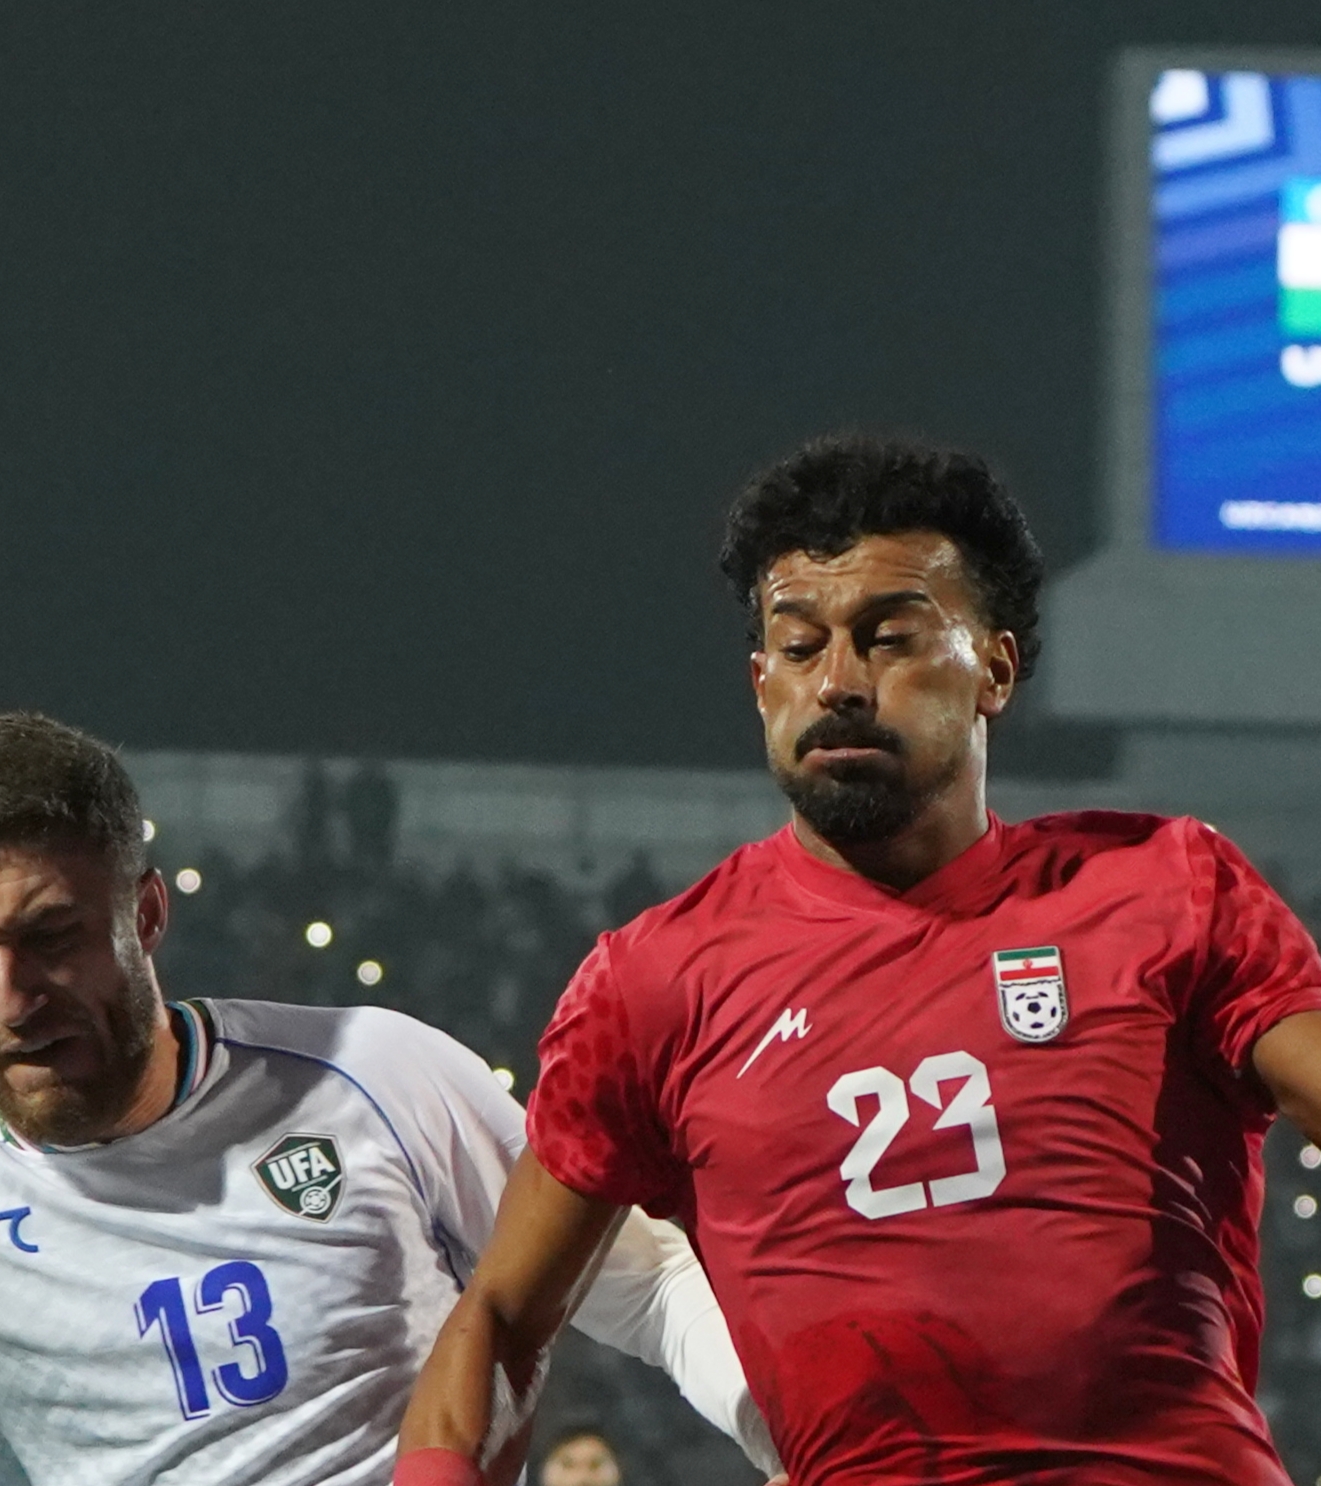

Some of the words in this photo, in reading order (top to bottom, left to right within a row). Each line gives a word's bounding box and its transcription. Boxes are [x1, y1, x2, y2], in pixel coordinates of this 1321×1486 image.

[267, 1146, 336, 1190] UFA
[826, 1050, 1007, 1220] 23
[134, 1259, 289, 1421] 13
